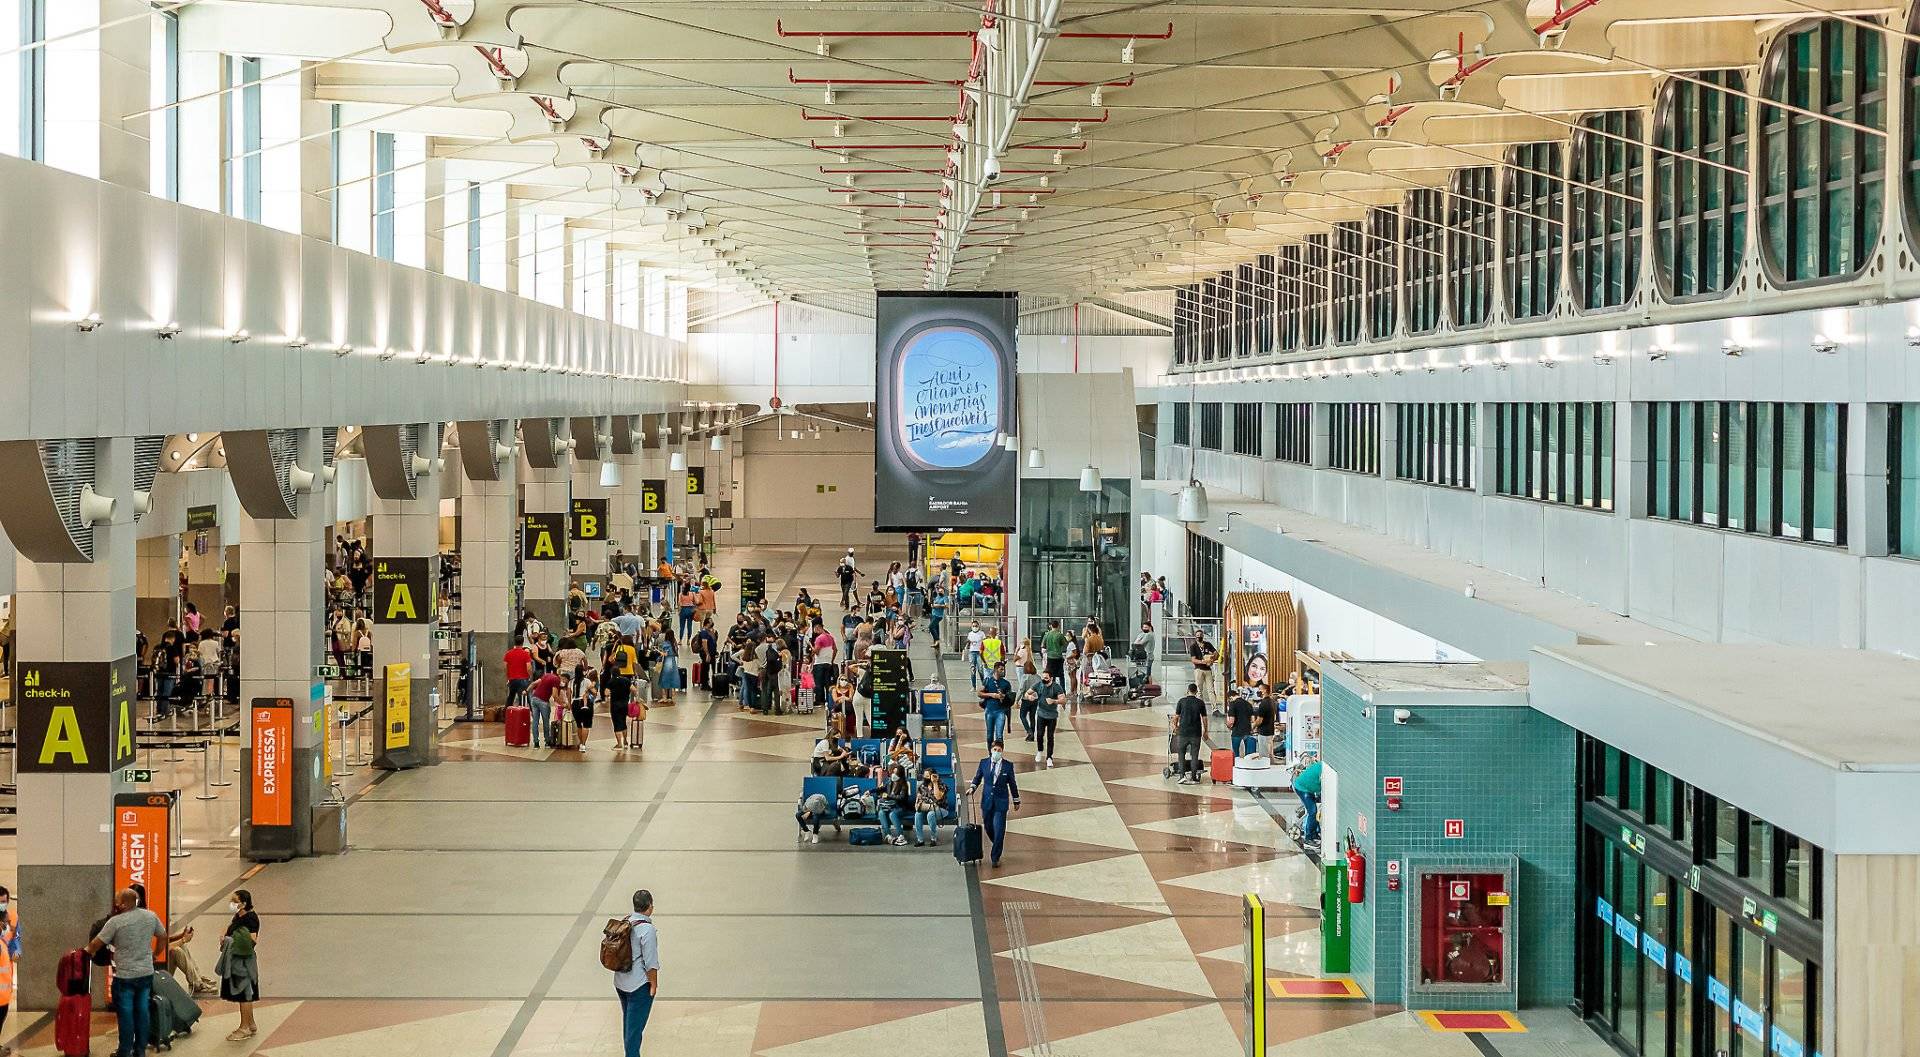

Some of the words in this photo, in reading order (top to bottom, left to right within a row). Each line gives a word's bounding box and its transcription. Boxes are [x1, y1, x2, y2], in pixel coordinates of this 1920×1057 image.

[688, 477, 698, 492] B
[644, 492, 658, 511] B
[580, 515, 597, 538] B
[533, 531, 556, 557] A
[386, 583, 417, 619] A
[25, 688, 71, 698] check-in
[277, 699, 292, 707] GOL
[38, 705, 89, 764] A
[117, 700, 132, 761] A
[263, 727, 276, 795] EXPRESSA
[147, 795, 168, 805] GOL
[1449, 822, 1460, 833] H
[130, 833, 145, 887] AGEM
